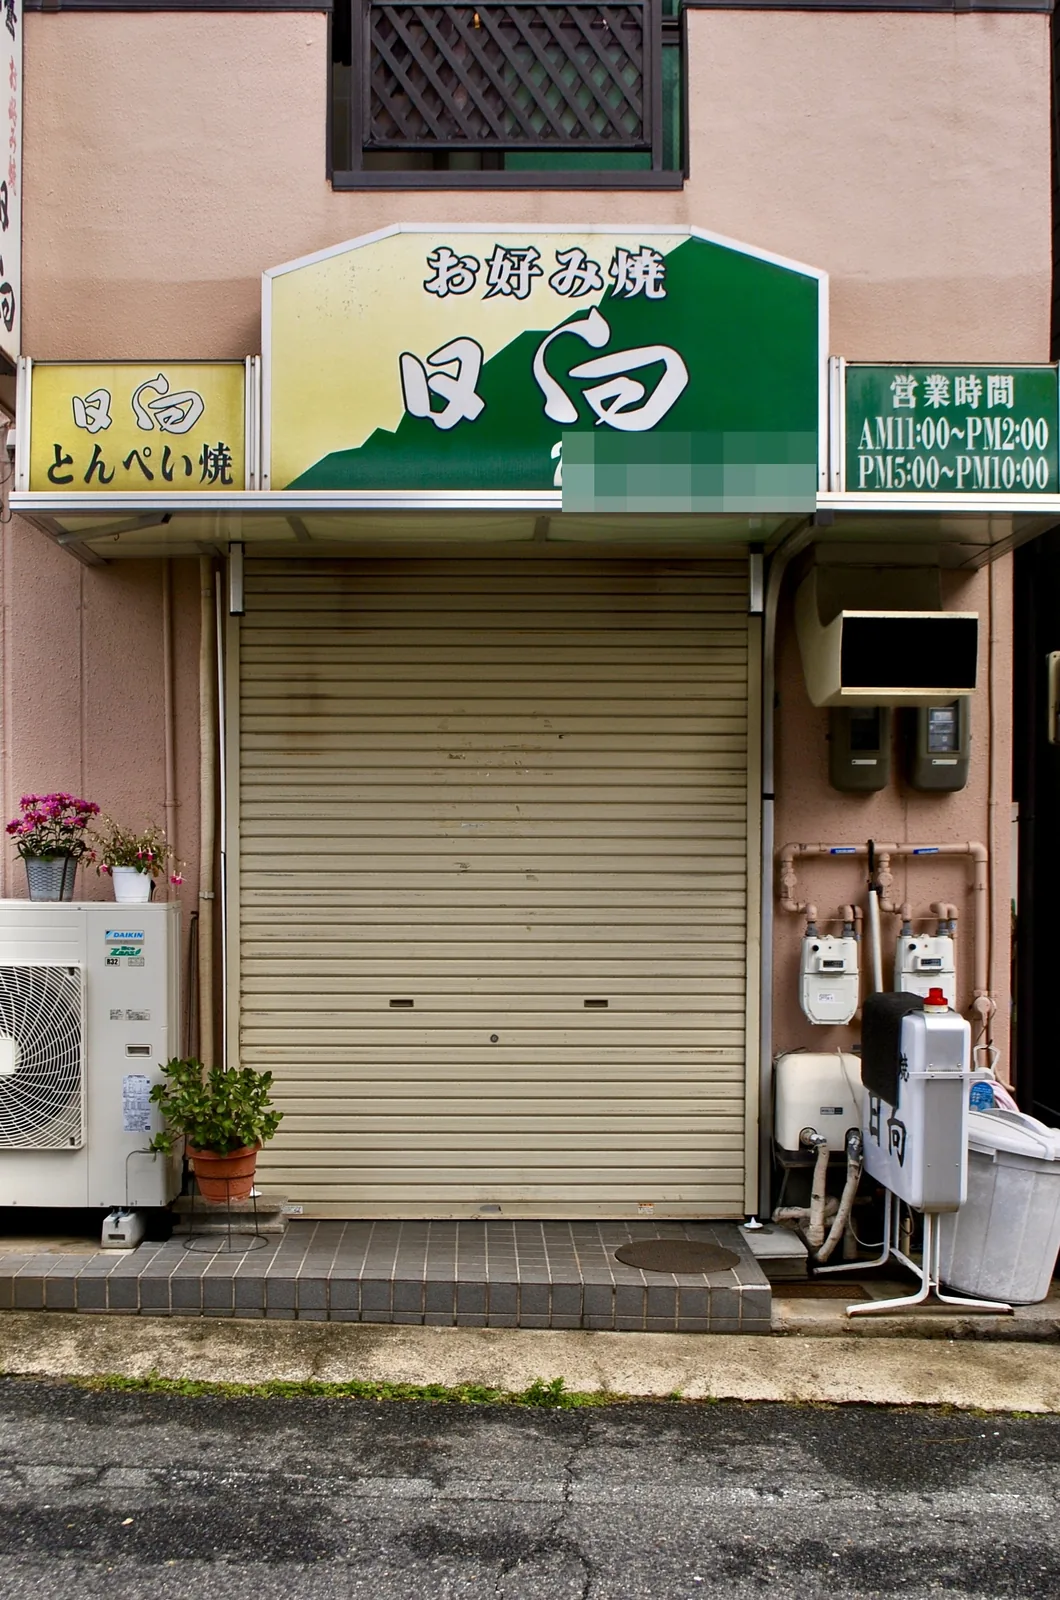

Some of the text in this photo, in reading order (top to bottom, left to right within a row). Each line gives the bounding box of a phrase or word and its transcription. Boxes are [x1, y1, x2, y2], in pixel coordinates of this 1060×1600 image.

[422, 242, 668, 300] お好み焼
[398, 304, 691, 432] 日向
[889, 374, 1016, 410] 営業時間
[72, 372, 205, 435] 日向
[47, 441, 234, 486] とんぺい焼
[106, 958, 118, 966] R32
